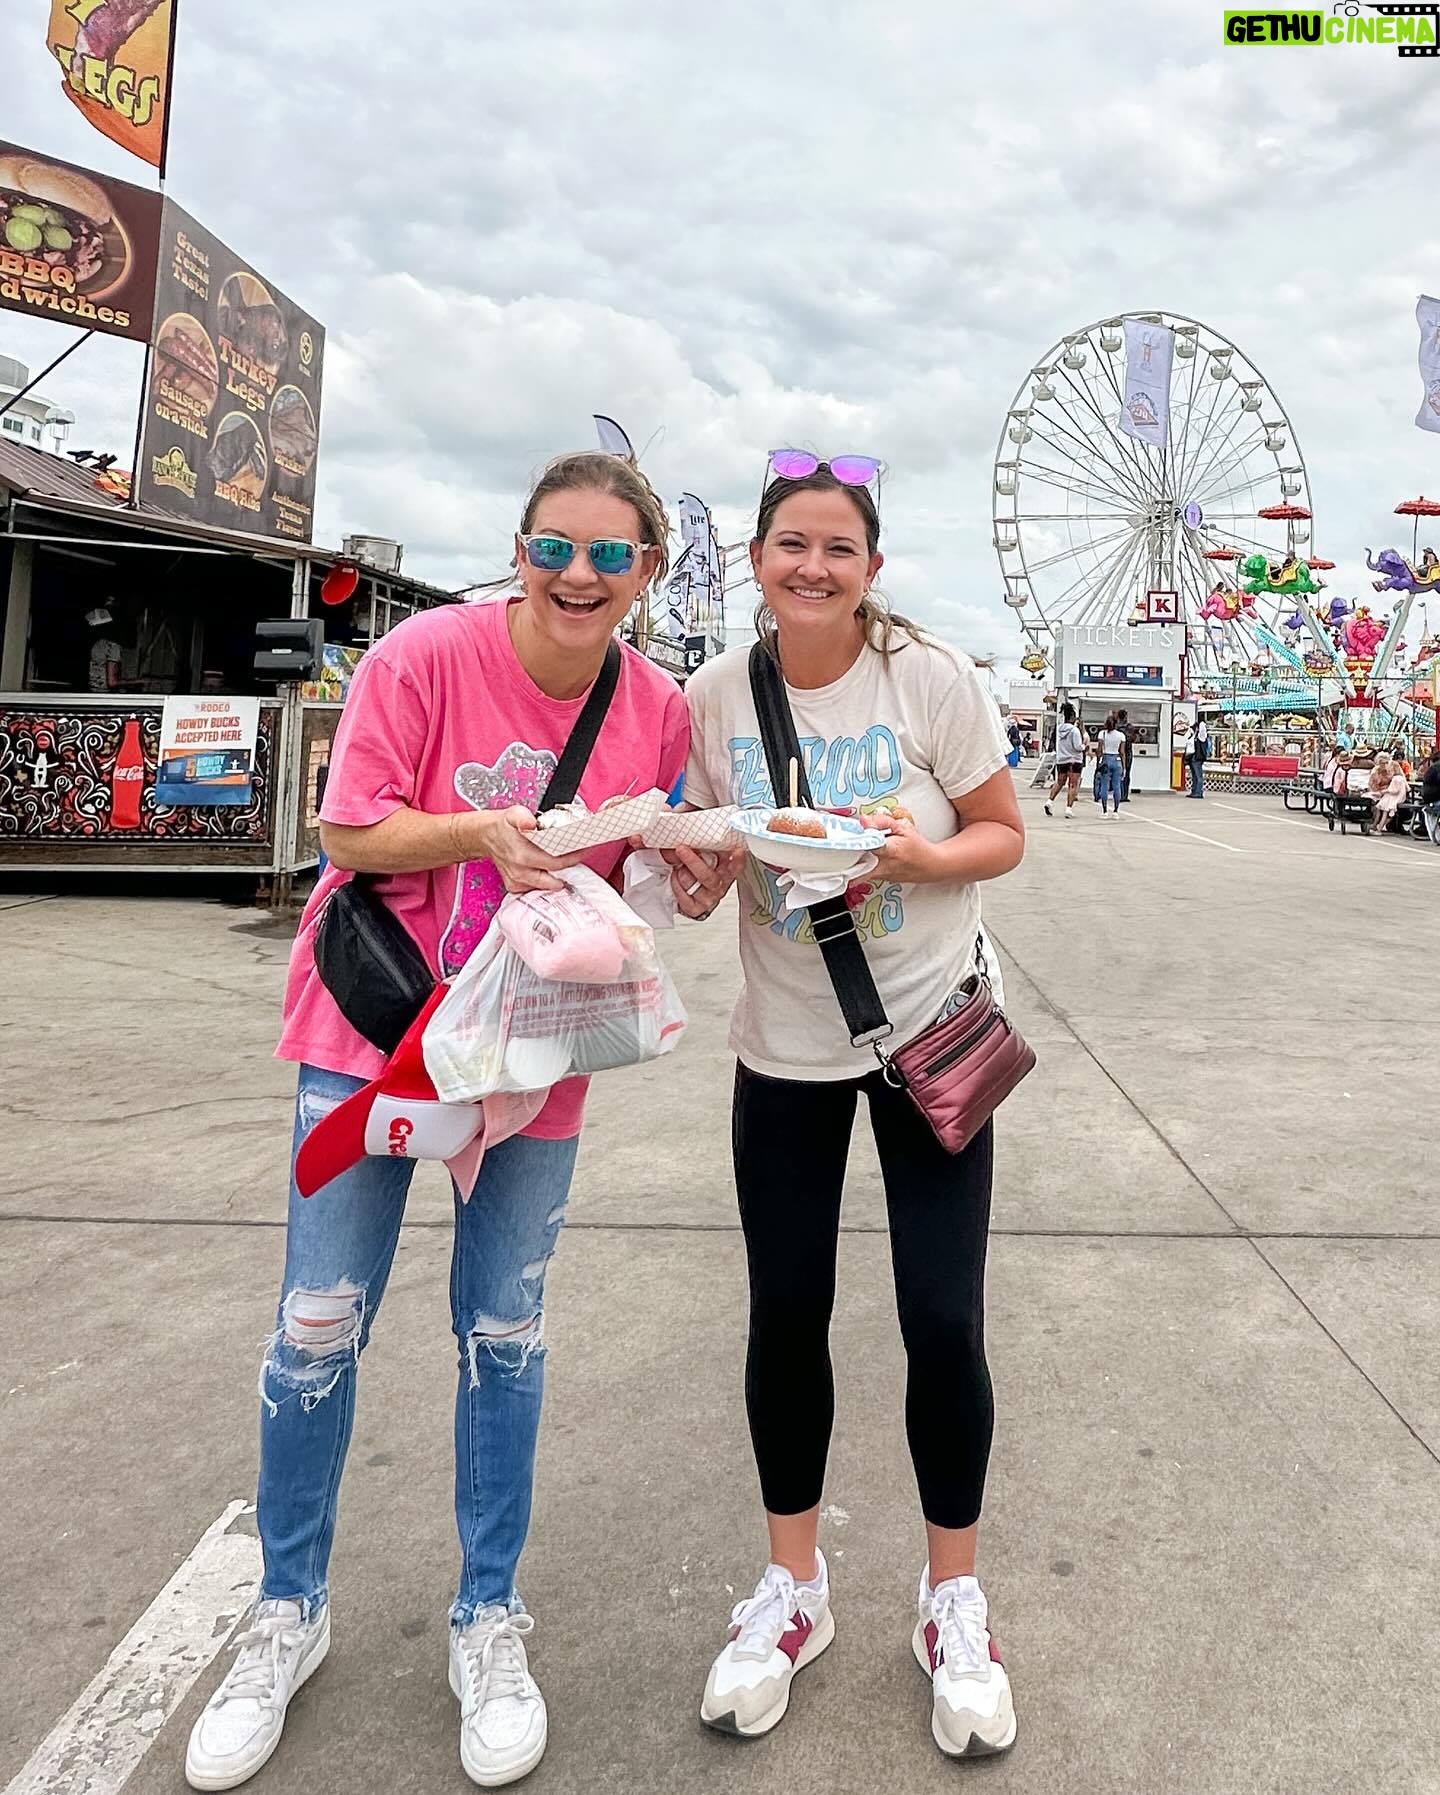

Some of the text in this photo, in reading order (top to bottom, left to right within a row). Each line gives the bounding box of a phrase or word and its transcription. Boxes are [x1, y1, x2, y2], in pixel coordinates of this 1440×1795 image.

[175, 246, 209, 285] Texas
[177, 232, 209, 268] Great
[0, 250, 76, 294] BBQ
[218, 335, 277, 395] Turkey
[160, 379, 207, 418] Sausage
[226, 368, 265, 411] Legs
[214, 480, 261, 512] BBQ Ribs
[689, 514, 705, 526] Lite
[1155, 598, 1172, 613] K
[1070, 626, 1174, 648] TICKETS
[176, 716, 241, 730] HOWDY BUCKS
[200, 703, 230, 713] RODEO
[175, 730, 243, 744] ACCEPTED HERE
